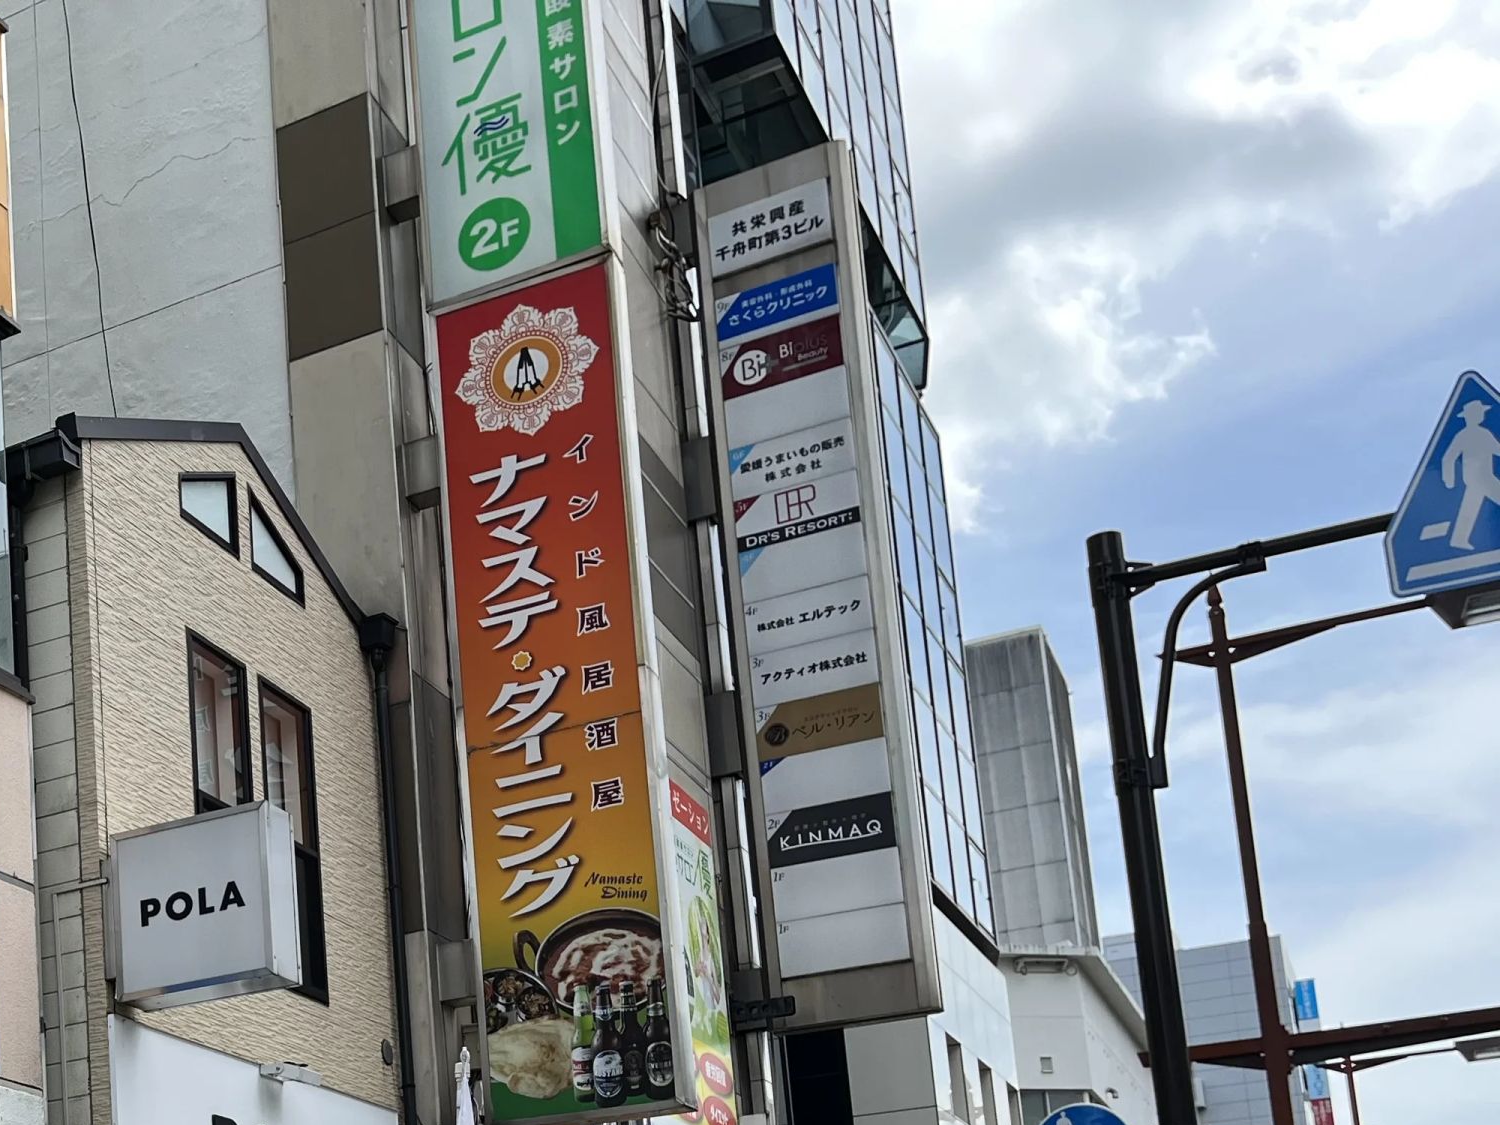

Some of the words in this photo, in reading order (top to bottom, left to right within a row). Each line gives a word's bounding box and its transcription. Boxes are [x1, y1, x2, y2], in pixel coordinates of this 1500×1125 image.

[731, 199, 806, 237] 共栄興産
[469, 217, 520, 259] 2F
[715, 214, 825, 262] 千舟町第3ビル
[728, 285, 829, 327] さくらクリニック
[764, 457, 824, 485] 株式会社
[563, 433, 626, 813] インド風居酒屋
[798, 599, 862, 625] エルテック
[760, 652, 869, 686] アクティオ株式会社
[779, 818, 883, 849] KINMAQ
[584, 871, 643, 888] Namaste
[601, 886, 648, 903] Dining
[139, 880, 246, 928] POLA
